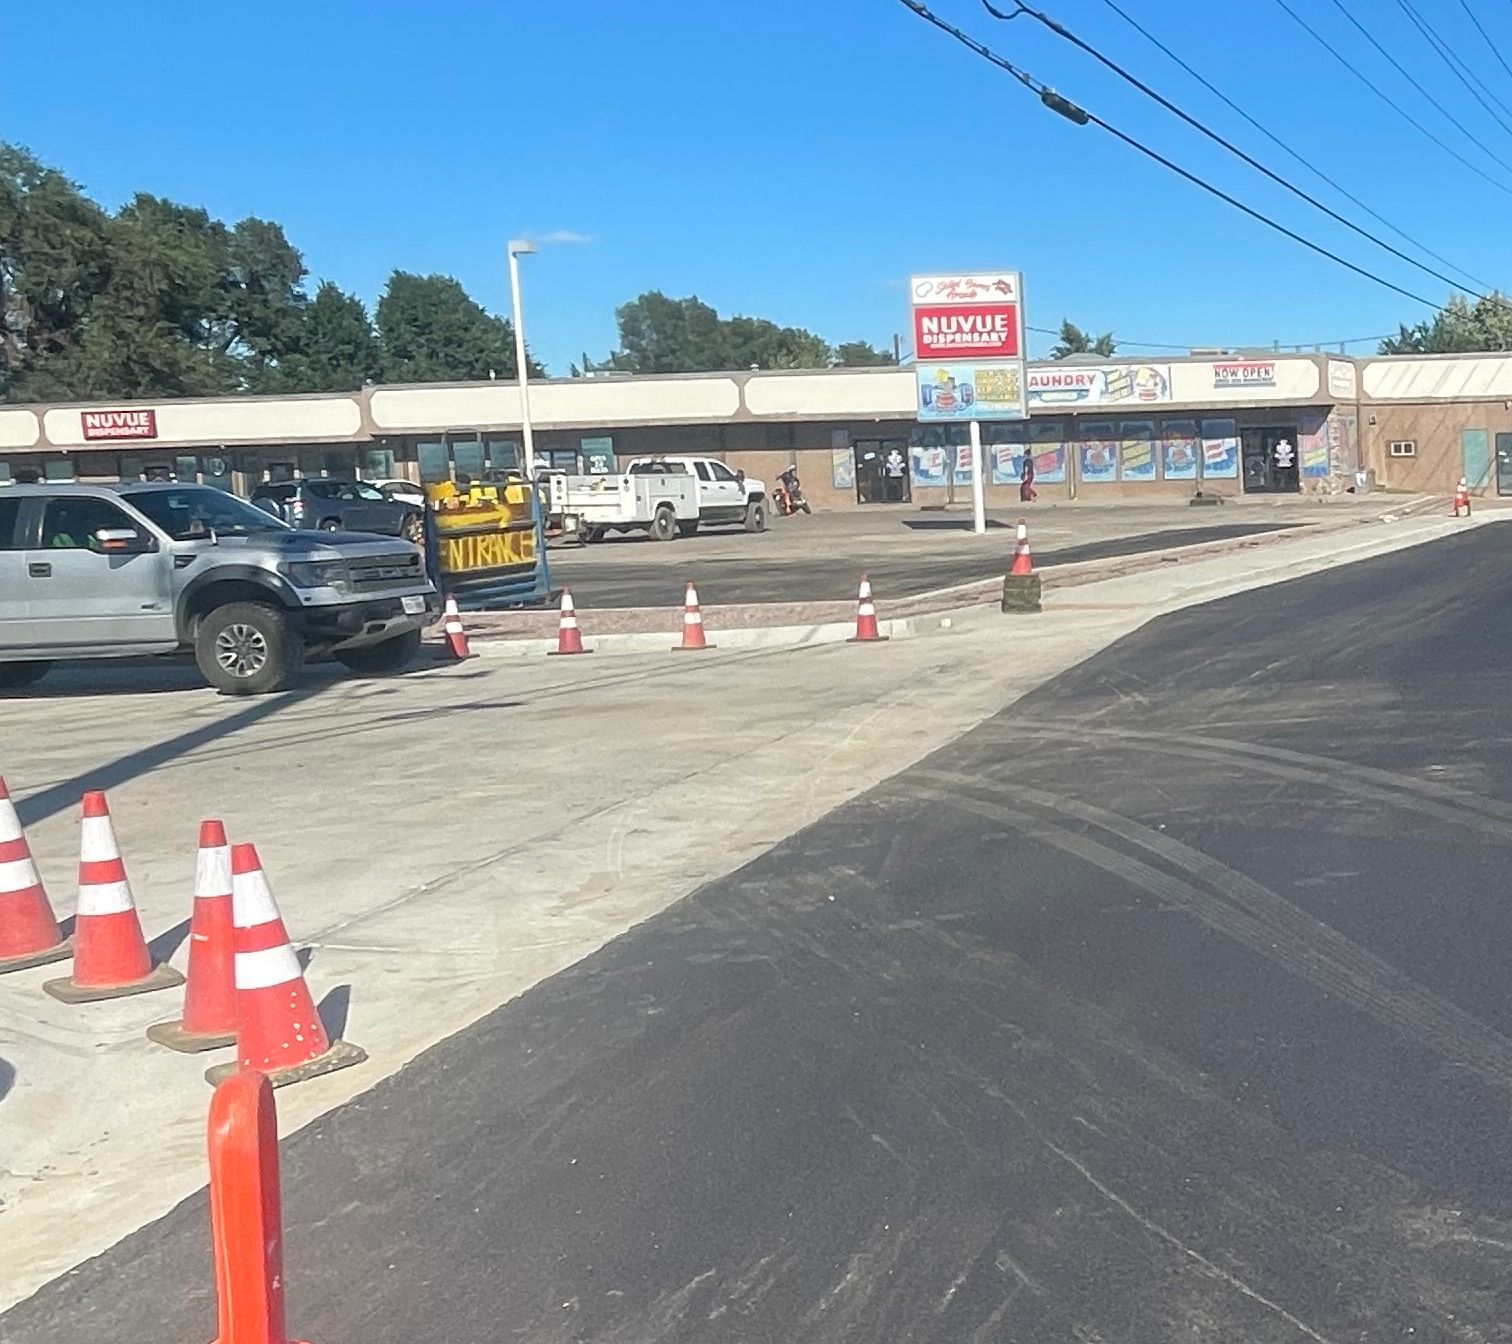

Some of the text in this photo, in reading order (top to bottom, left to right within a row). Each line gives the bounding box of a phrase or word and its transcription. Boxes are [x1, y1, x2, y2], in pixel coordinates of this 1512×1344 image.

[922, 314, 1008, 334] NUVUE
[922, 332, 1008, 344] DISPENSARY
[1214, 366, 1270, 378] NOW OPEN
[1028, 374, 1097, 387] AUNDRY
[85, 412, 150, 428] NUVUE
